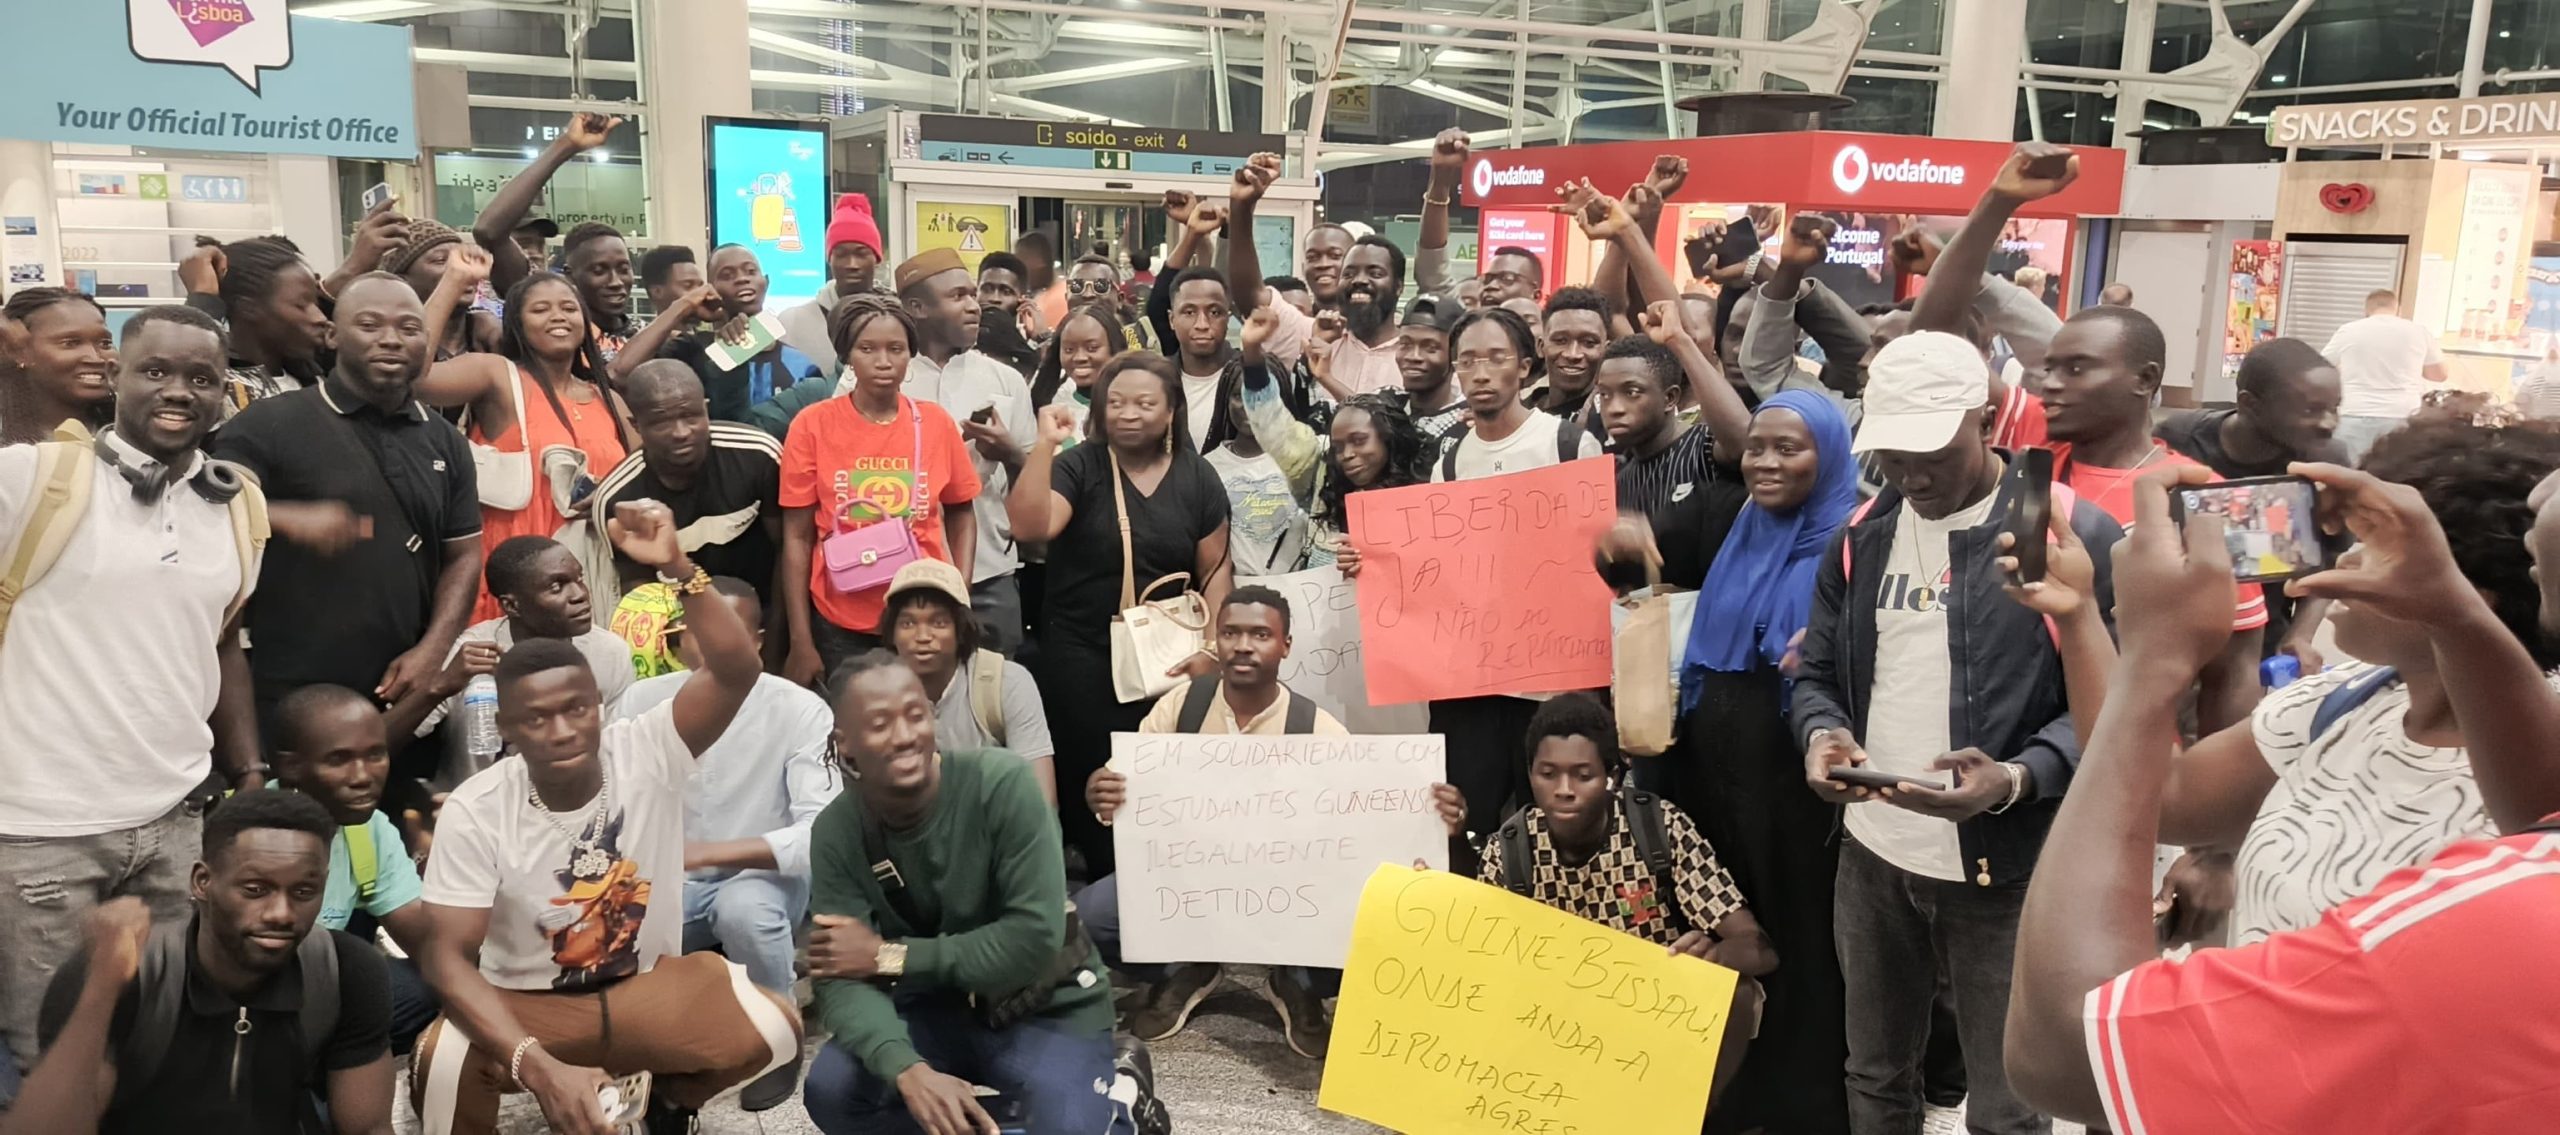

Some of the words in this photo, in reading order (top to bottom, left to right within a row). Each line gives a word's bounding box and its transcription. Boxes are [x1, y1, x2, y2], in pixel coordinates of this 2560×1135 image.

[57, 101, 121, 130] Your
[127, 107, 227, 136] Official
[231, 112, 322, 140] Tourist
[326, 117, 399, 144] Office
[2279, 107, 2417, 142] SNACKS
[2426, 106, 2450, 136] &
[2459, 100, 2560, 136] DRIN
[1134, 133, 1164, 148] exit
[1177, 134, 1188, 149] 4
[1493, 164, 1545, 186] vodafone
[1872, 158, 1965, 185] vodafone
[622, 212, 634, 225] in
[1824, 247, 1884, 268] Portugal
[856, 456, 909, 471] GUCCI
[1135, 740, 1183, 774] EM
[1200, 738, 1379, 769] SOLIDARIEDADE
[1395, 741, 1441, 764] COM
[1136, 790, 1297, 826] ESTUDANTES
[1156, 885, 1319, 921] DETIDOS
[1374, 957, 1487, 1012] ONDE
[1516, 1003, 1604, 1064] ANDA
